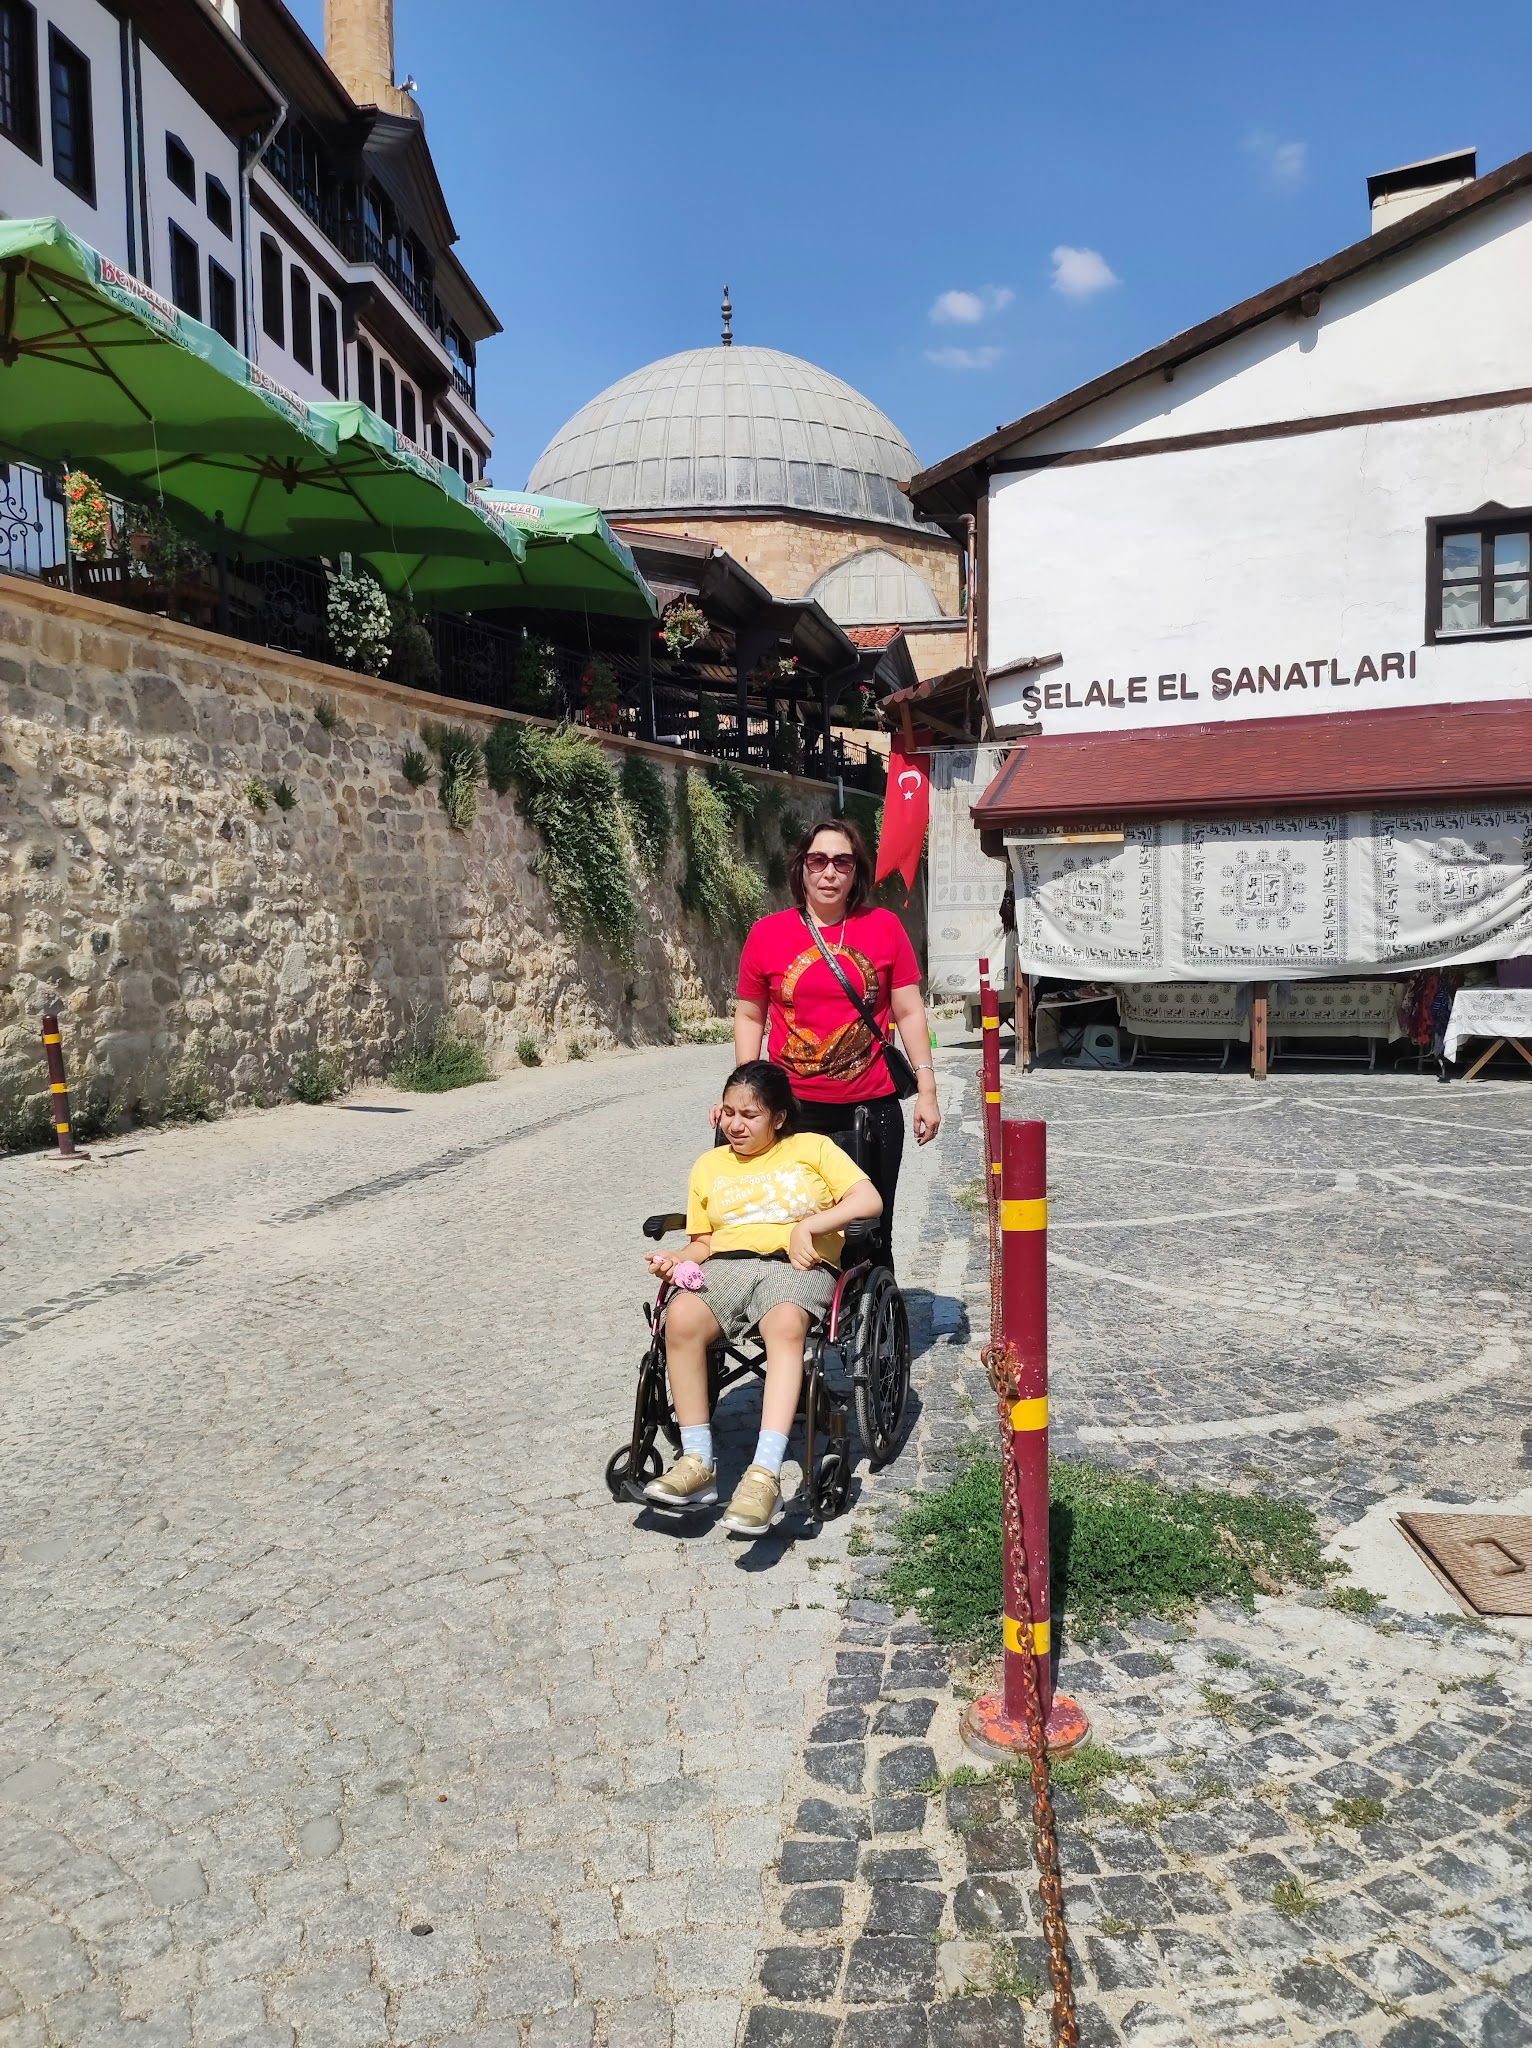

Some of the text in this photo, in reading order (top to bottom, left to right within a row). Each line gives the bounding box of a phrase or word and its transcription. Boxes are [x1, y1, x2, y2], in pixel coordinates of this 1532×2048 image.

[1021, 650, 1416, 719] ŞELALE EL SANATLARI
